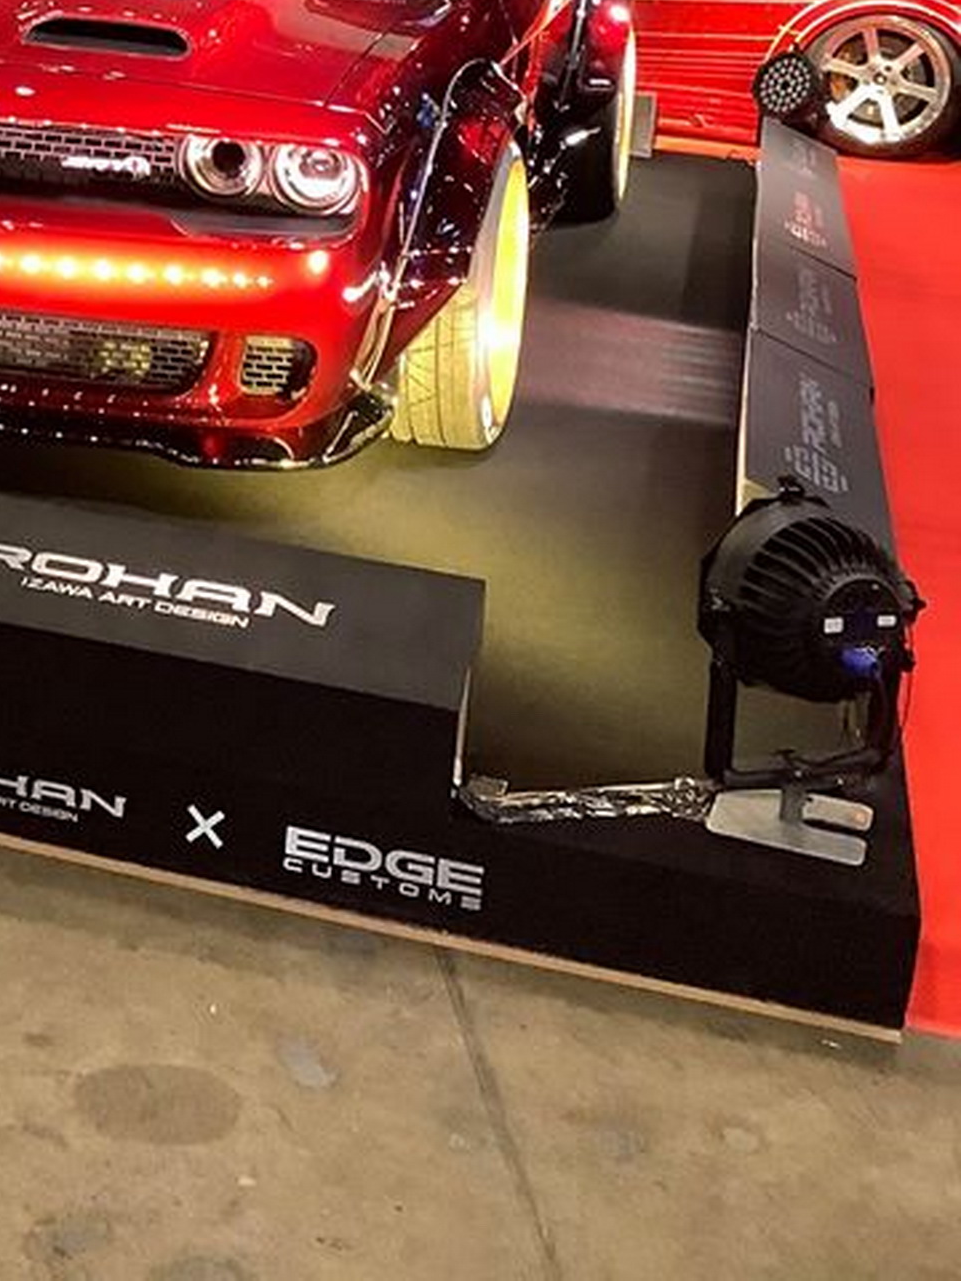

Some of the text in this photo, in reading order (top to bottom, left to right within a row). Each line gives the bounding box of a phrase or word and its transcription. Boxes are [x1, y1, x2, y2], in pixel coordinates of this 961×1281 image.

[20, 576, 250, 630] IZAWA ART DESIGN
[17, 800, 80, 824] DESIGN
[282, 856, 482, 912] CUSTOMS
[284, 825, 486, 897] EDGE
